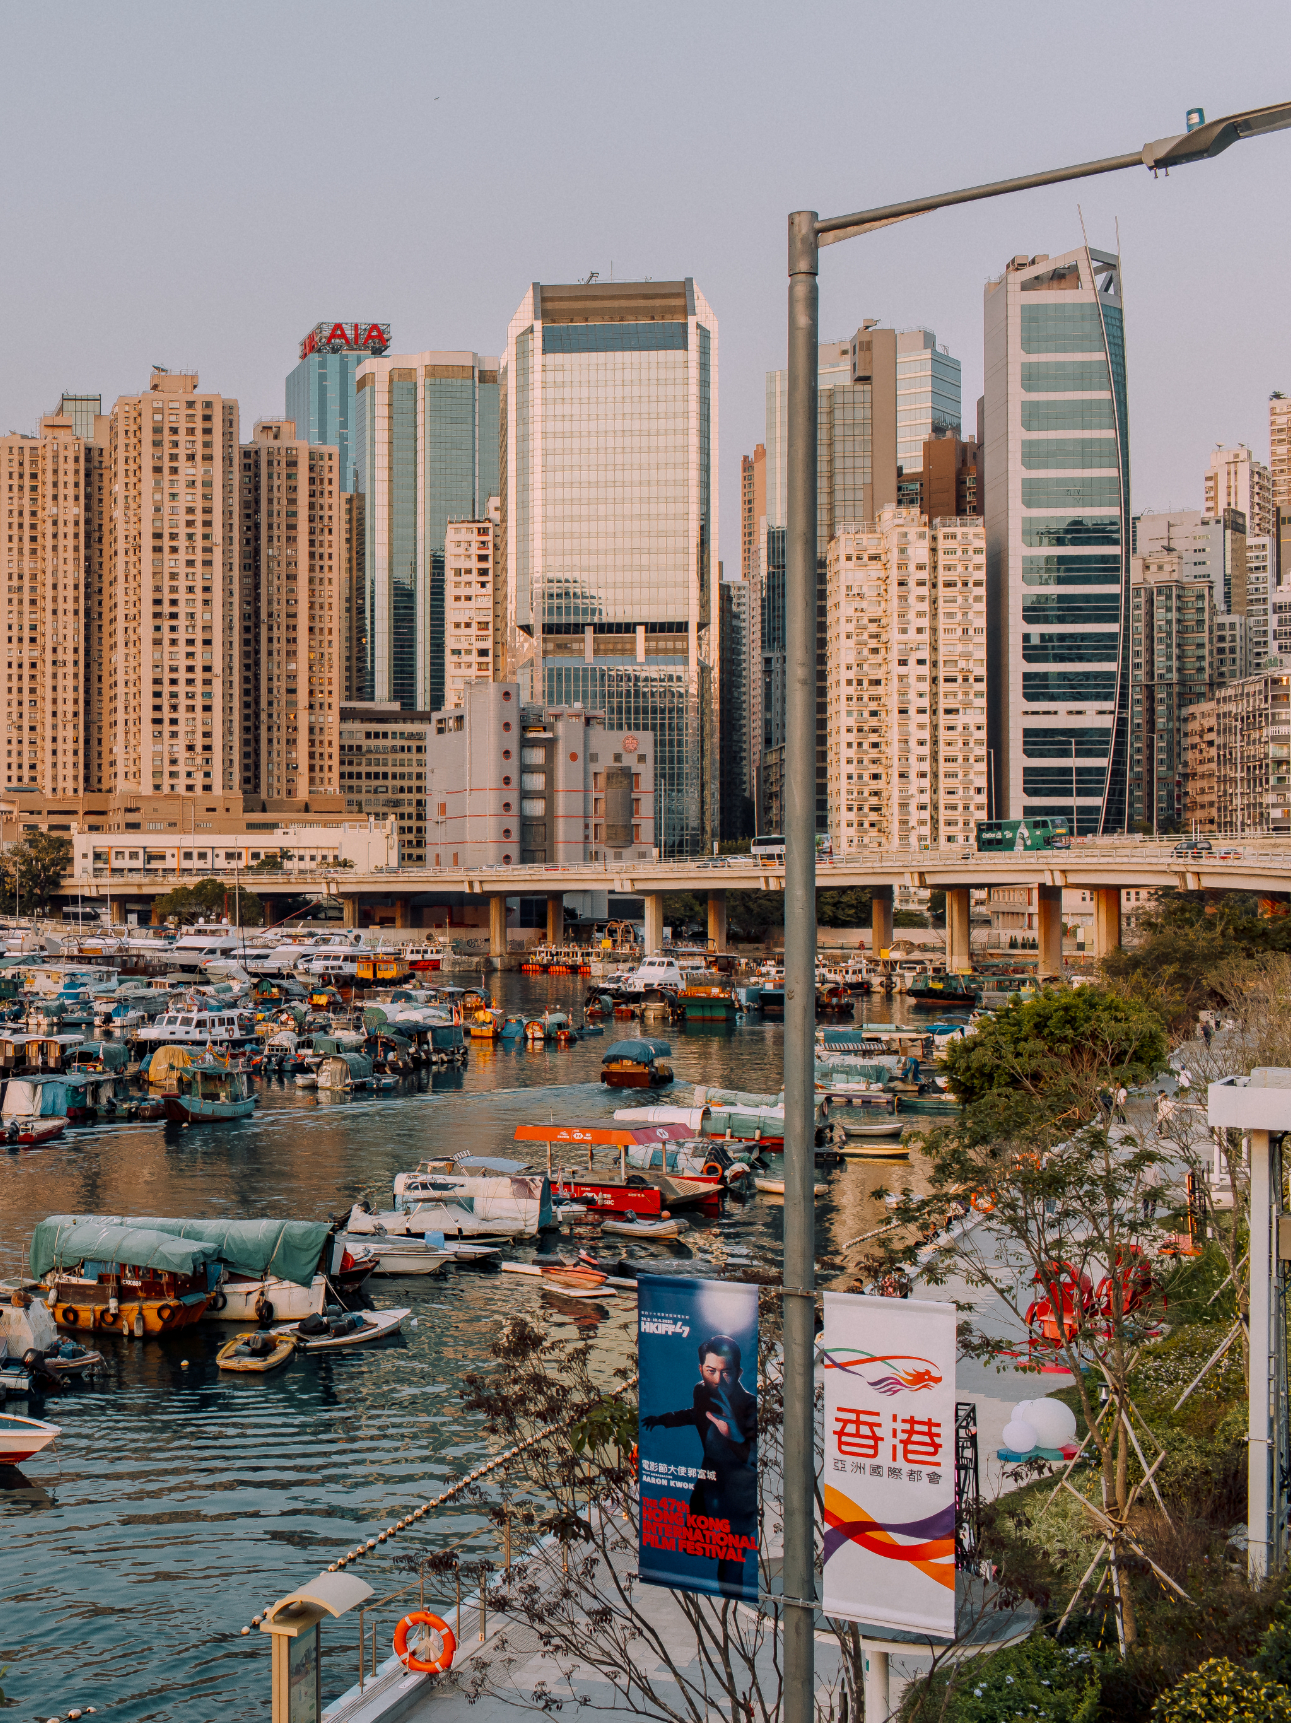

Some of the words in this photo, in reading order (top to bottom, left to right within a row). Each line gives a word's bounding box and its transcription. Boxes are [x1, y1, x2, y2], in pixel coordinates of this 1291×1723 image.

[326, 323, 387, 346] AIA
[832, 1406, 943, 1467] 香港
[641, 1459, 717, 1481] 電影節大使郭富城
[642, 1474, 668, 1486] AARON
[669, 1480, 695, 1490] KWOK
[832, 1458, 943, 1485] 亞洲國際都會
[641, 1496, 658, 1508] THE
[658, 1497, 690, 1514] 47th
[642, 1505, 684, 1526] HONG
[686, 1513, 731, 1533] KONG
[642, 1519, 758, 1550] INTERNATIONAL
[642, 1532, 676, 1552] FILM
[678, 1539, 746, 1563] FESTIVAL
